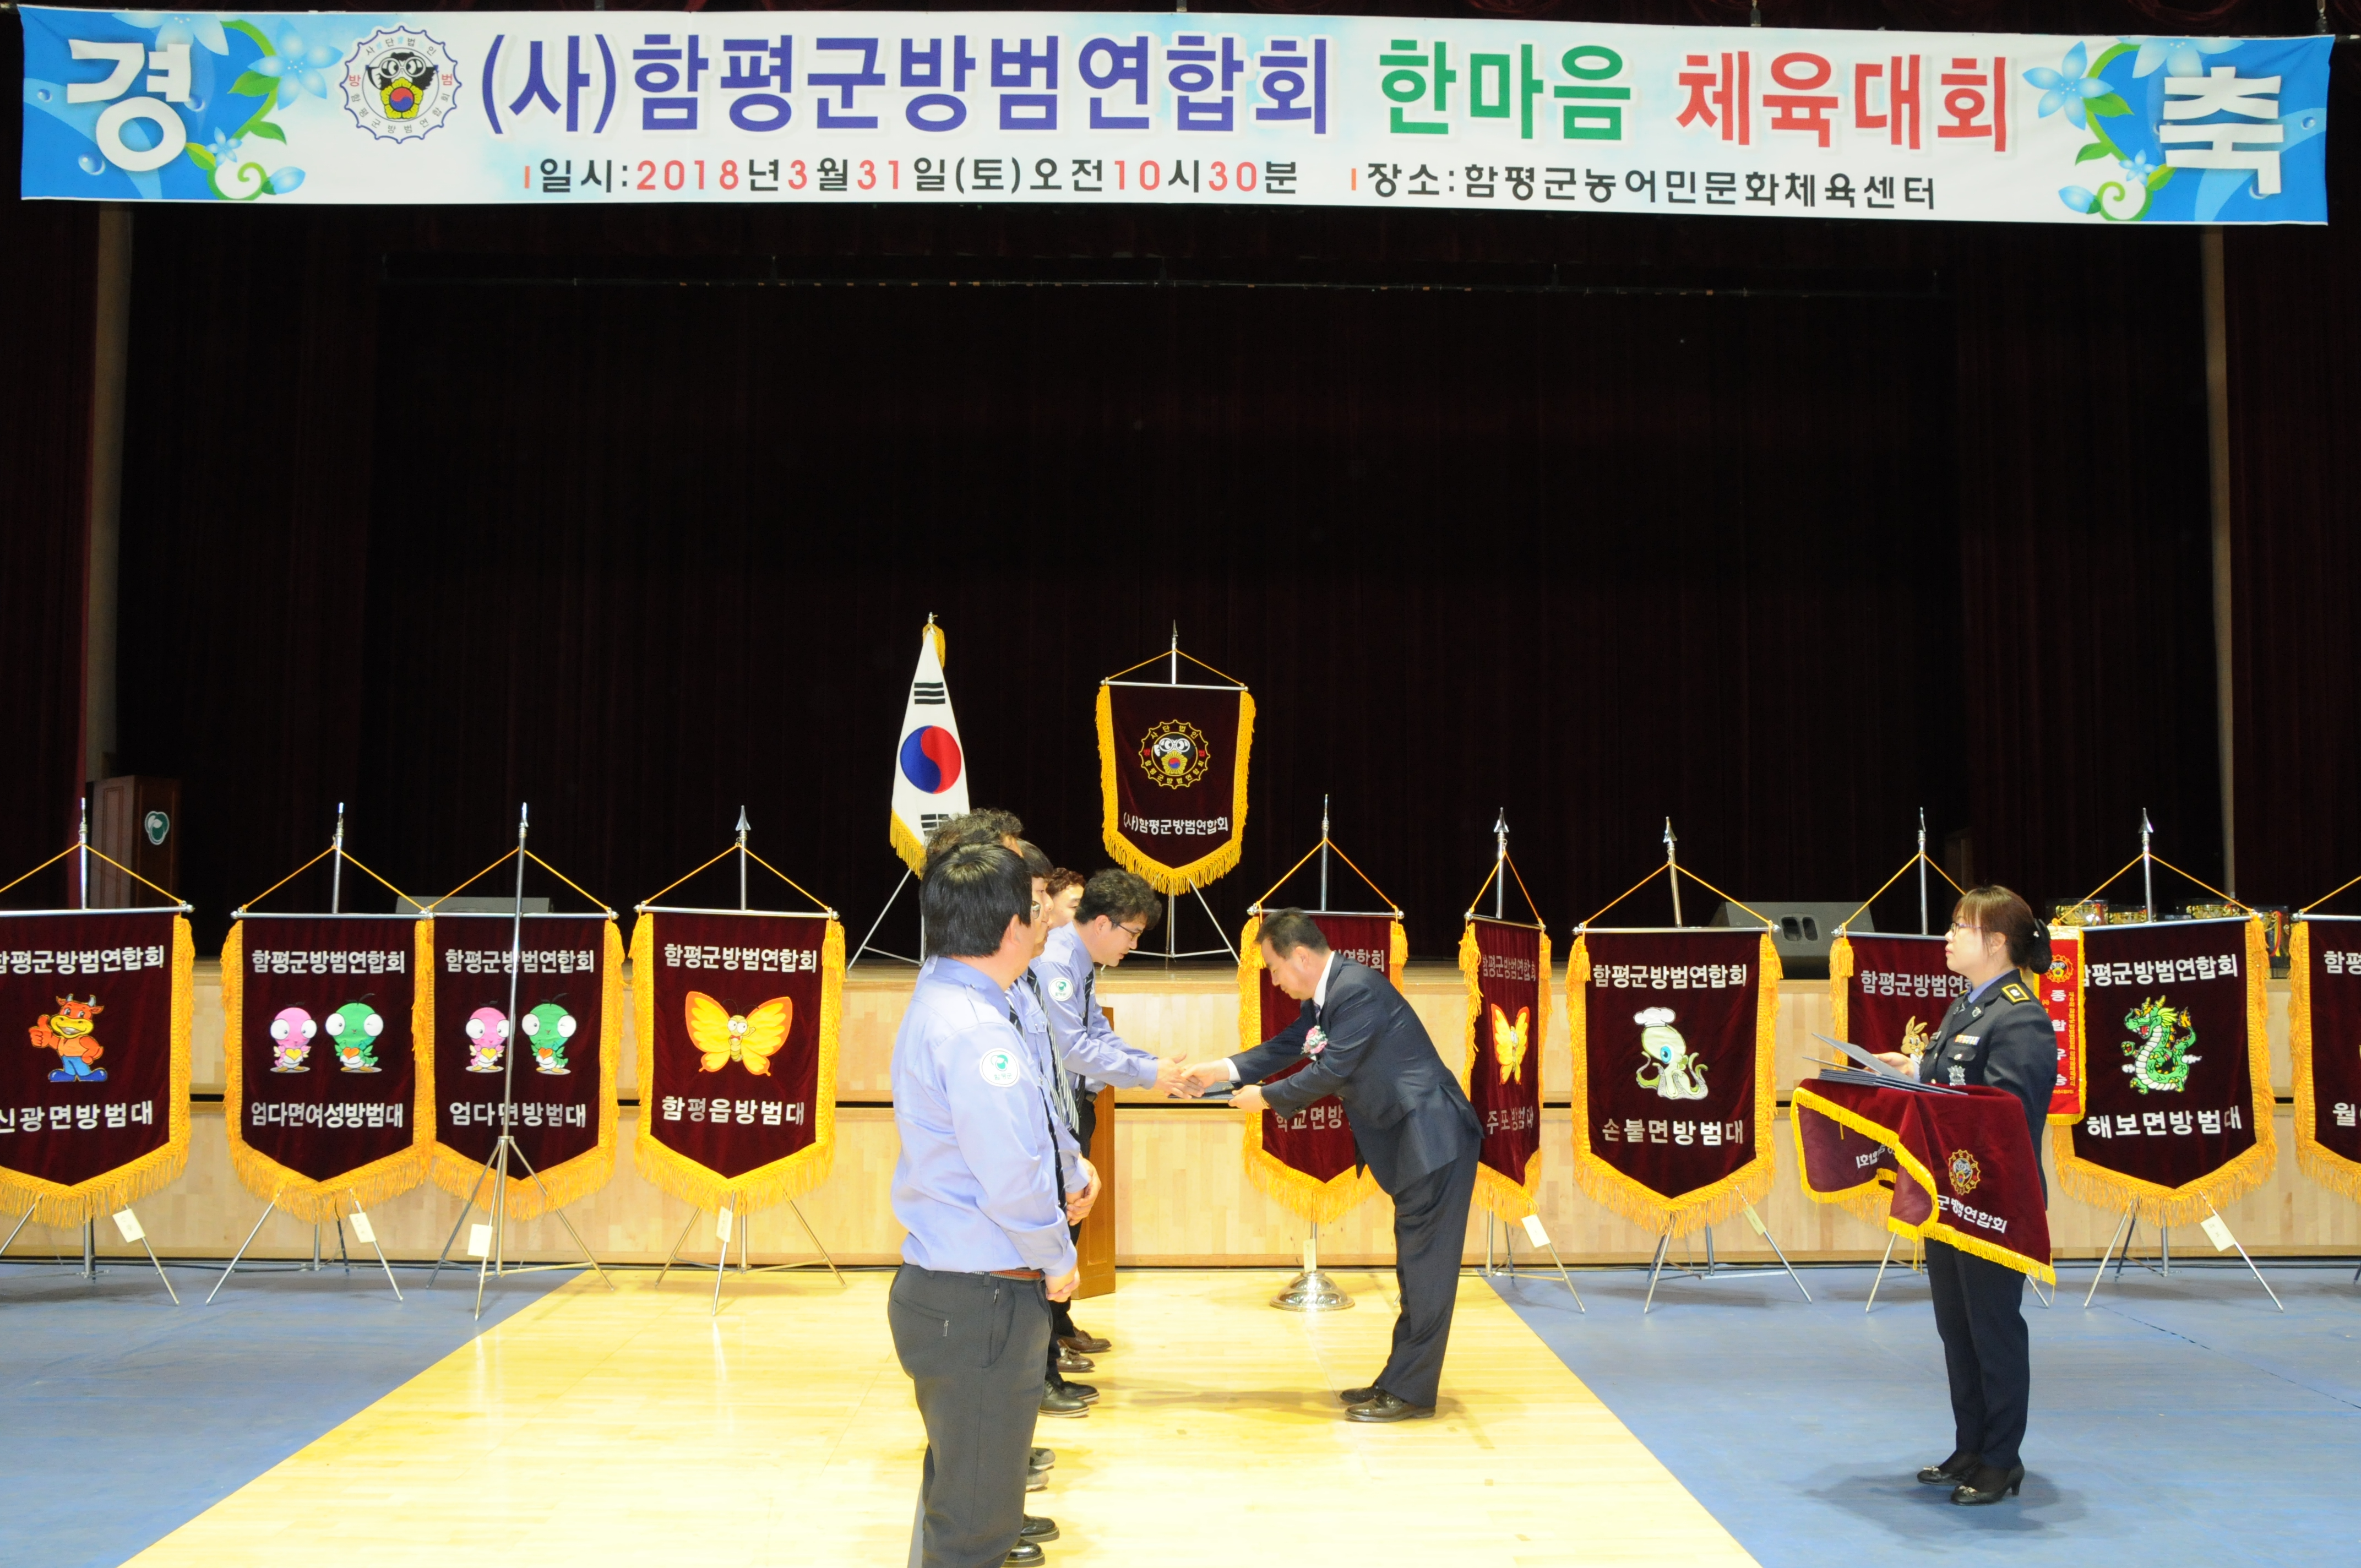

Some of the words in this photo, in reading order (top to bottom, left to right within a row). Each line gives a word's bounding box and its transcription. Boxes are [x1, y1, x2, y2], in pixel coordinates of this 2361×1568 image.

[67, 39, 192, 172] 경
[481, 35, 1326, 134] (사)함평군방범연합회
[1380, 39, 1631, 140] 한마음
[1677, 51, 2007, 152] 체육대회
[2158, 66, 2284, 195] 축
[1123, 812, 1228, 835] (사)함평군방범연합회
[252, 950, 405, 974] 함평군방범연합회
[445, 949, 594, 974] 함평군방범연합회
[664, 943, 817, 973] 함평군방범연합회
[1593, 963, 1747, 989] 함평군방범연합회
[251, 1102, 403, 1128] 엄다면여성방범대
[449, 1101, 586, 1128] 엄다면방범대
[662, 1096, 804, 1125] 함평읍방범대
[2086, 1106, 2242, 1139] 해보면방범대
[1602, 1118, 1743, 1146] 손불면방범대
